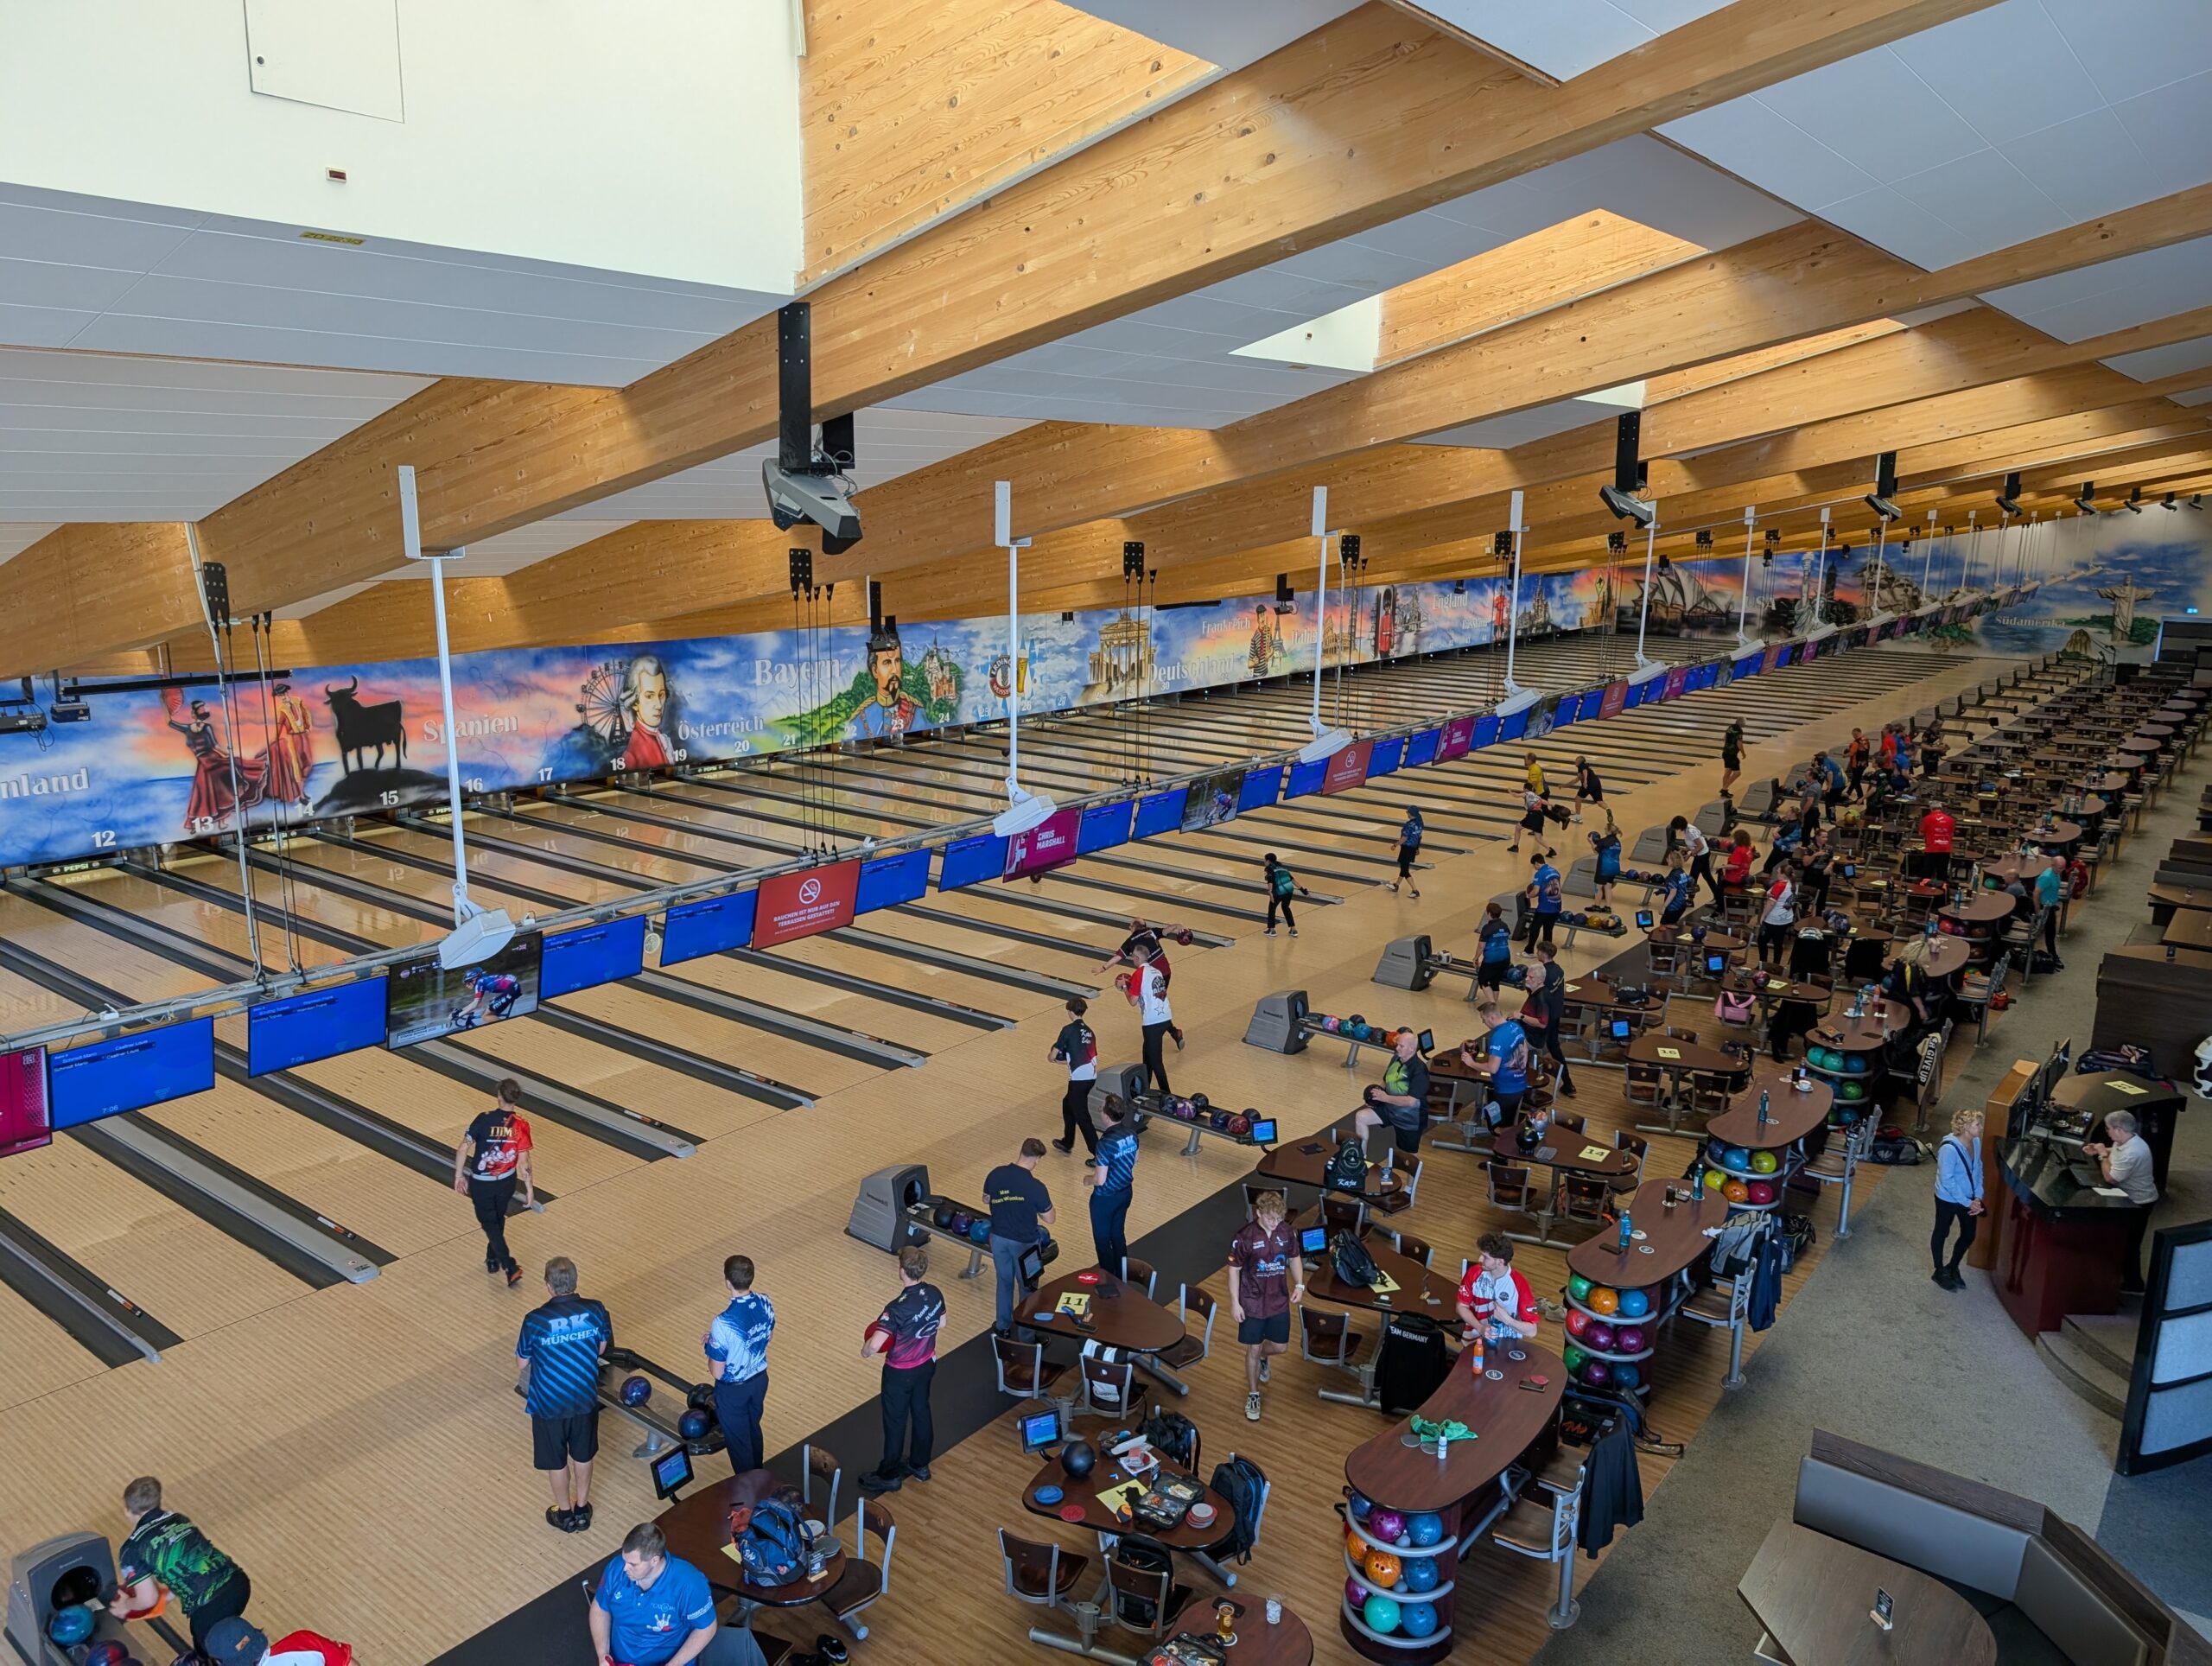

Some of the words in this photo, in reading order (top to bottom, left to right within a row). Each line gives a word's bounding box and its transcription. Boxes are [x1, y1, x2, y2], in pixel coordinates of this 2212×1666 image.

[1433, 591, 1468, 610] England
[1202, 617, 1251, 634] Frankreich
[1996, 614, 2066, 627] Südamerika
[755, 659, 840, 689] Bayern
[1148, 652, 1236, 683] Deutschland
[1161, 681, 1170, 691] 30
[1020, 700, 1033, 711] 26
[1057, 696, 1067, 707] 27
[938, 713, 950, 724] 24
[978, 707, 990, 719] 25
[678, 716, 765, 741] Österreich
[842, 725, 857, 736] 22
[891, 719, 905, 730] 23
[734, 740, 750, 753] 20
[783, 734, 796, 747] 21
[673, 749, 687, 762] 19
[610, 757, 626, 771] 18
[537, 766, 553, 782] 17
[465, 778, 484, 792] 16
[380, 790, 399, 805] 15
[294, 801, 315, 817] 14
[192, 816, 213, 833] 13
[92, 830, 117, 848] 12
[266, 833, 288, 842] PESI
[1038, 830, 1055, 842] CHRIS
[1036, 836, 1065, 850] MARSHALL
[63, 863, 89, 873] PEPSI
[773, 911, 798, 923] RAUCHEN
[807, 906, 818, 915] NUR
[830, 900, 841, 909] DEN
[778, 916, 806, 928] TERRASSEN
[1922, 1049, 1935, 1071] GIVE
[1918, 1071, 1929, 1083] UP
[1585, 1148, 1605, 1157] 14
[1063, 1296, 1084, 1306] 11
[548, 1313, 589, 1334] BK
[540, 1327, 600, 1346] MÜNCHEN
[1402, 1330, 1429, 1344] GERMANY
